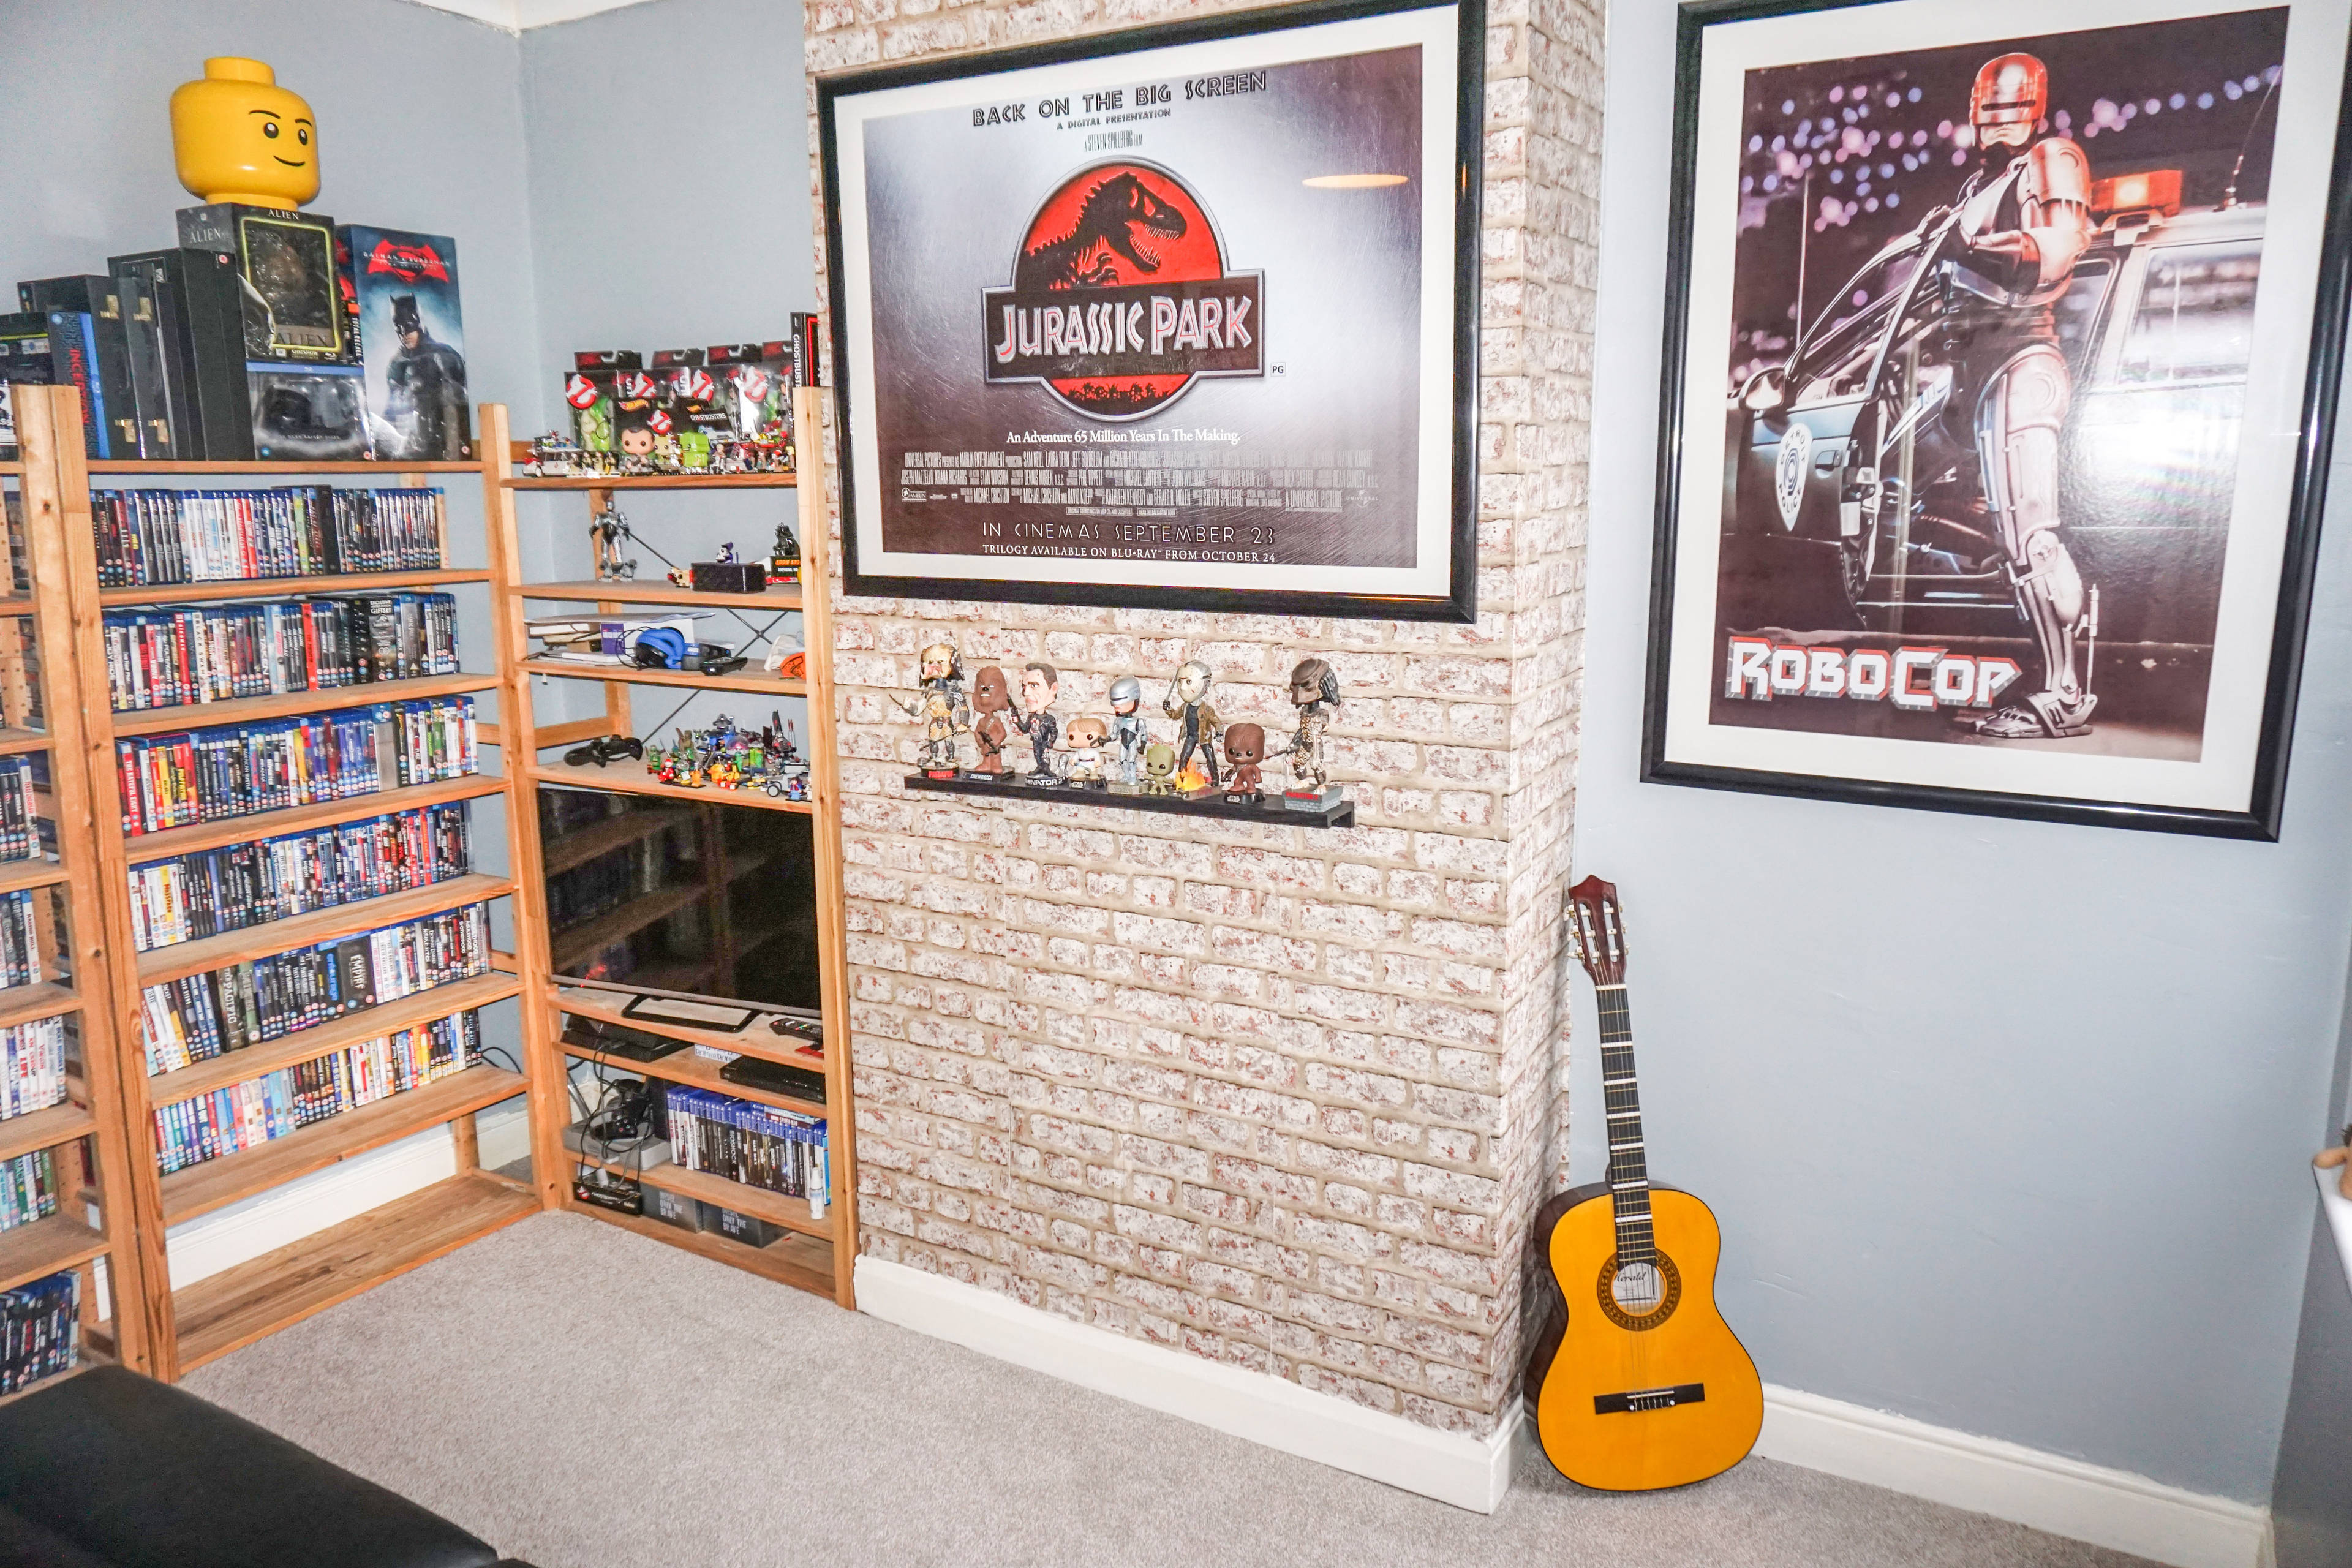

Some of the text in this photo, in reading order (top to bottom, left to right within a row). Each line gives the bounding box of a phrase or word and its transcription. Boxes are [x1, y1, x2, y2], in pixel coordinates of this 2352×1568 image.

[973, 70, 1267, 128] BACK ON THE BIG SCREEN
[1068, 118, 1101, 129] DIGITAL
[1106, 108, 1171, 124] PRESENTATION
[1088, 133, 1106, 152] STEVEN
[1107, 130, 1133, 149] SPIELBERG
[268, 209, 300, 221] ALIEN
[189, 227, 222, 244] ALIEN
[363, 251, 450, 266] BATMAN SUPERMAN
[352, 317, 363, 358] TOTAL RECALL
[994, 295, 1252, 364] JURASSIC PARK
[1272, 366, 1284, 374] PG
[1006, 429, 1241, 445] An Adventure 65 Million Years In The Making.
[1780, 429, 1806, 465] DETROIT
[1068, 488, 1343, 508] DAVID KATHLEEN STEVEN SPIELBERG A UNIVERSAL PICTURE
[1779, 484, 1801, 514] POLICE
[982, 522, 1275, 545] IN CINEMAS SEPTEMBER 23
[982, 543, 1028, 555] TRILOGY
[1031, 545, 1088, 557] AVAILABLE
[1090, 547, 1107, 557] ON
[1165, 549, 1199, 560] FROM
[1202, 551, 1259, 562] OCTOBER
[1262, 552, 1276, 562] 24
[260, 636, 269, 675] TAKEN
[325, 952, 339, 1001] entourage
[352, 954, 365, 990] EMPIRE
[223, 981, 237, 1023] PACIFIC
[332, 1061, 341, 1093] DOGMA
[660, 1199, 684, 1214] ONLY THE
[722, 1214, 747, 1228] ONLY THE
